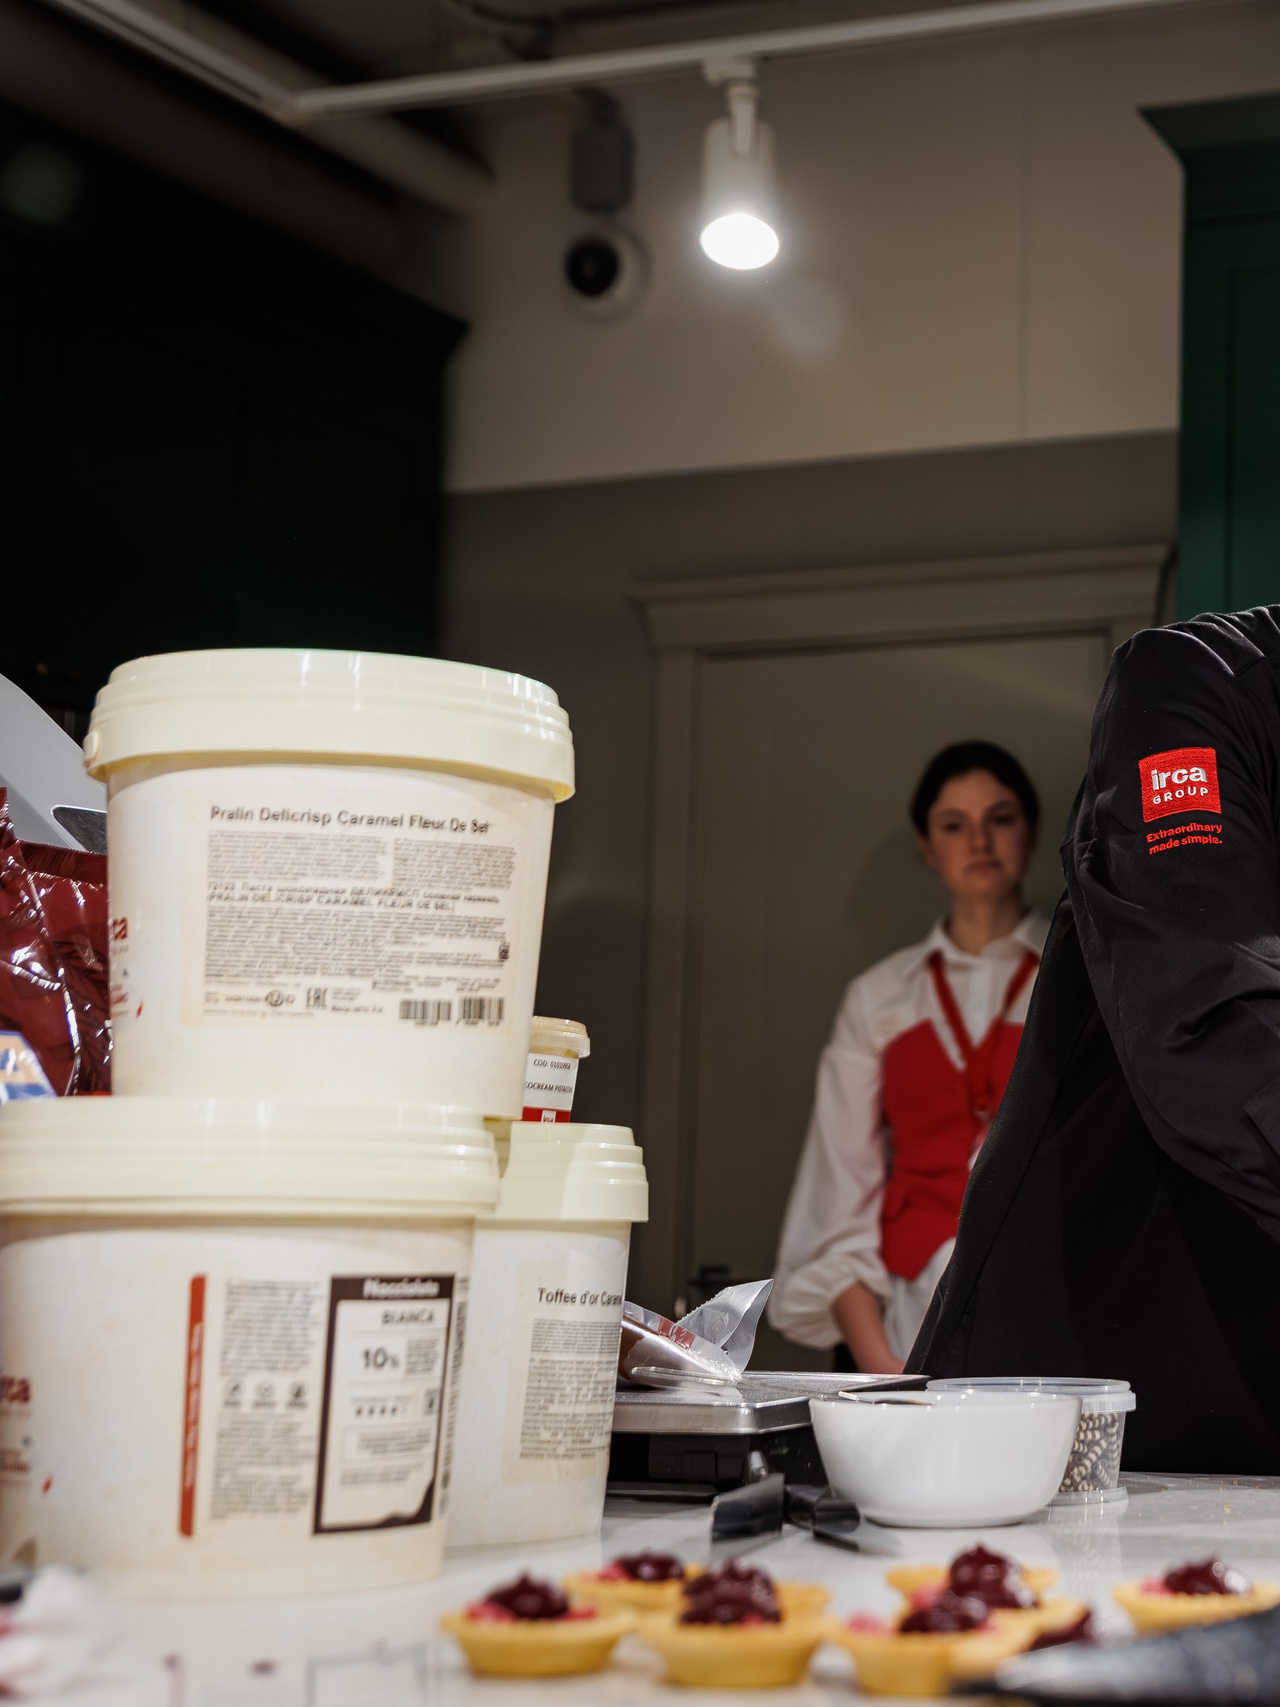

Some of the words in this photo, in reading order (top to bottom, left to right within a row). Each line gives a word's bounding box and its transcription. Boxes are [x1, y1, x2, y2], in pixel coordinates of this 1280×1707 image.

[1150, 766, 1208, 791] irca
[1152, 786, 1209, 805] GROUP
[210, 804, 254, 821] Pralin
[259, 807, 332, 826] Delicrisp
[337, 810, 404, 827] Caramel
[409, 814, 446, 830] Fleur
[450, 817, 467, 832] De
[1146, 822, 1223, 843] Extraordinary
[1149, 838, 1180, 855] made
[1181, 834, 1223, 845] simple.
[537, 1287, 578, 1304] Toffee
[580, 1289, 600, 1305] d'or
